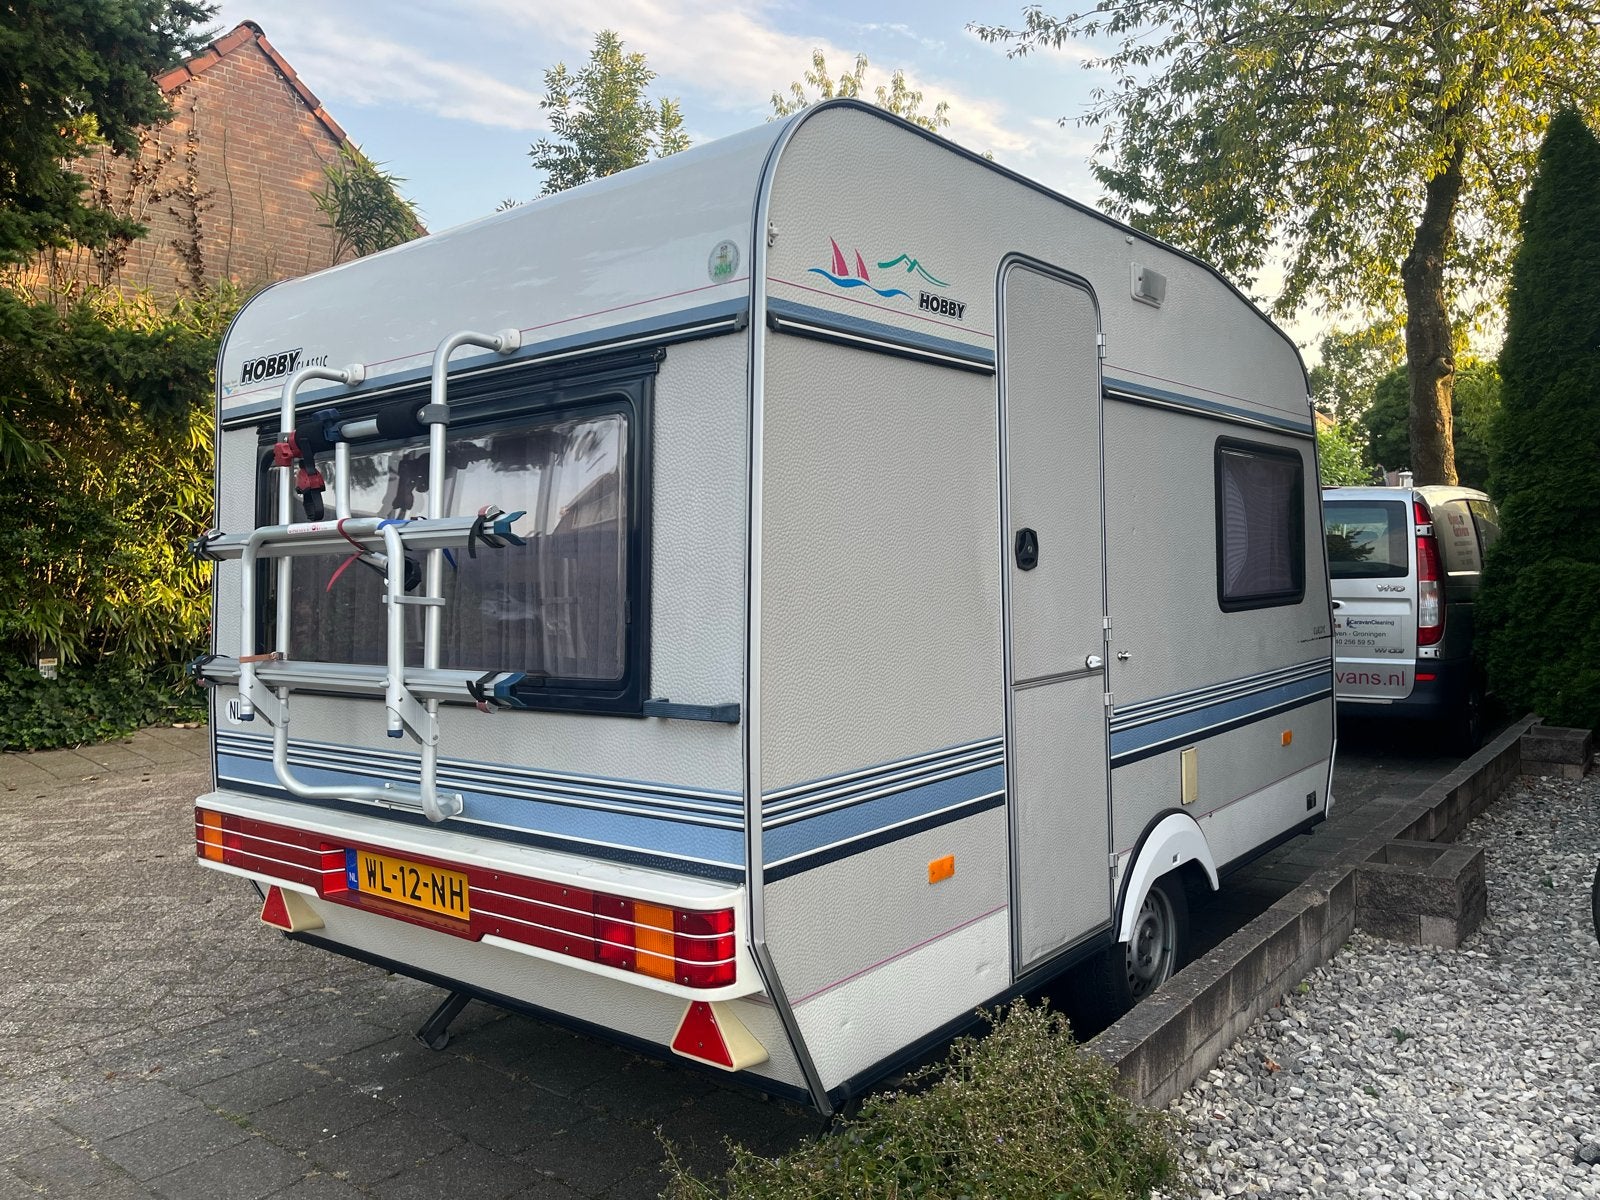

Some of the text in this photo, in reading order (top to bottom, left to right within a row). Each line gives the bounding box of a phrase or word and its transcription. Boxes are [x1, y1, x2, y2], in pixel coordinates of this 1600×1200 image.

[919, 290, 967, 321] HOBBY
[240, 347, 303, 386] HOBBY
[1335, 671, 1405, 687] vans.nl
[229, 700, 242, 720] NL
[349, 857, 464, 913] NL WL-12-NH
